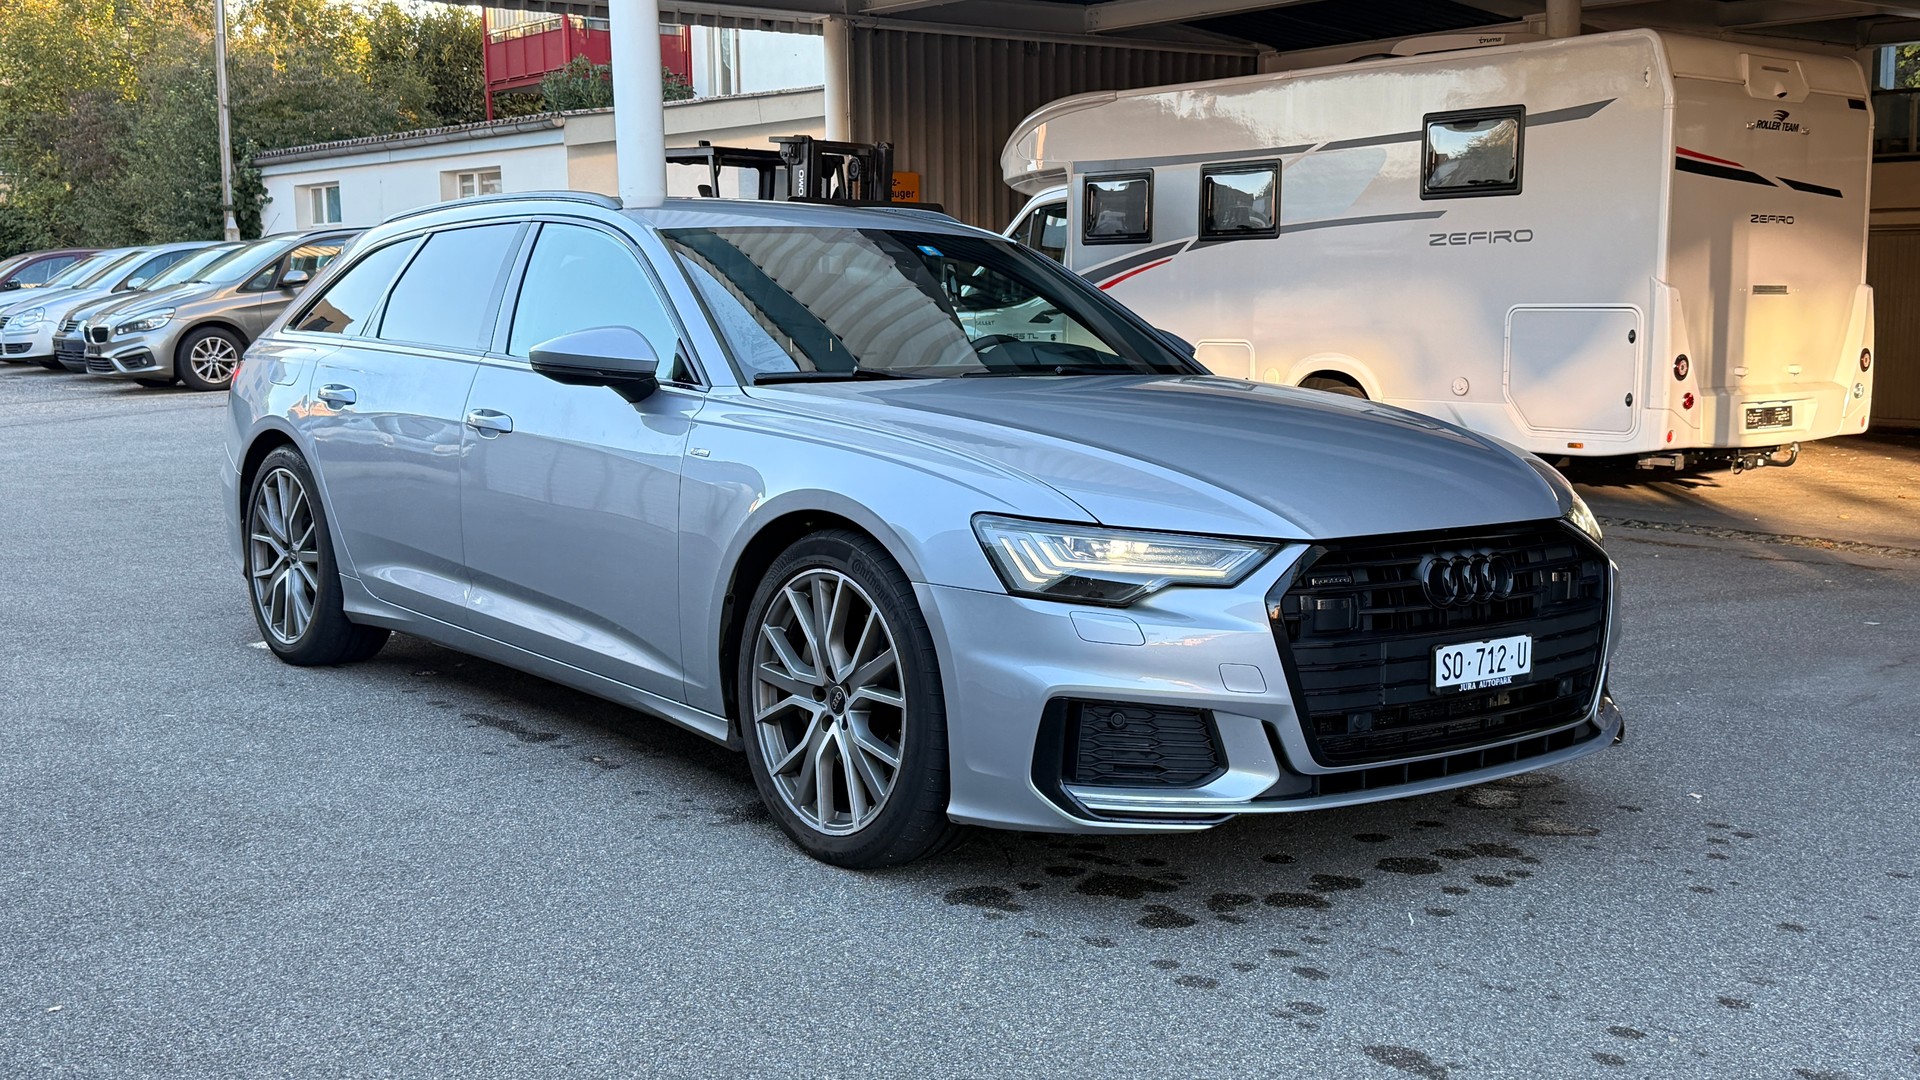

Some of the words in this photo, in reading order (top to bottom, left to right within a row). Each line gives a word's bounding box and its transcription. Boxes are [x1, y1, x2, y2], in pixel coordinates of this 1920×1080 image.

[1756, 119, 1781, 131] ROLLER
[1782, 122, 1800, 132] TEAM
[891, 190, 916, 201] auger
[1750, 214, 1795, 225] ZEFIRO
[1429, 229, 1534, 246] ZEFIRO
[1458, 681, 1477, 692] JURA
[1478, 676, 1513, 689] AUTOPARK
